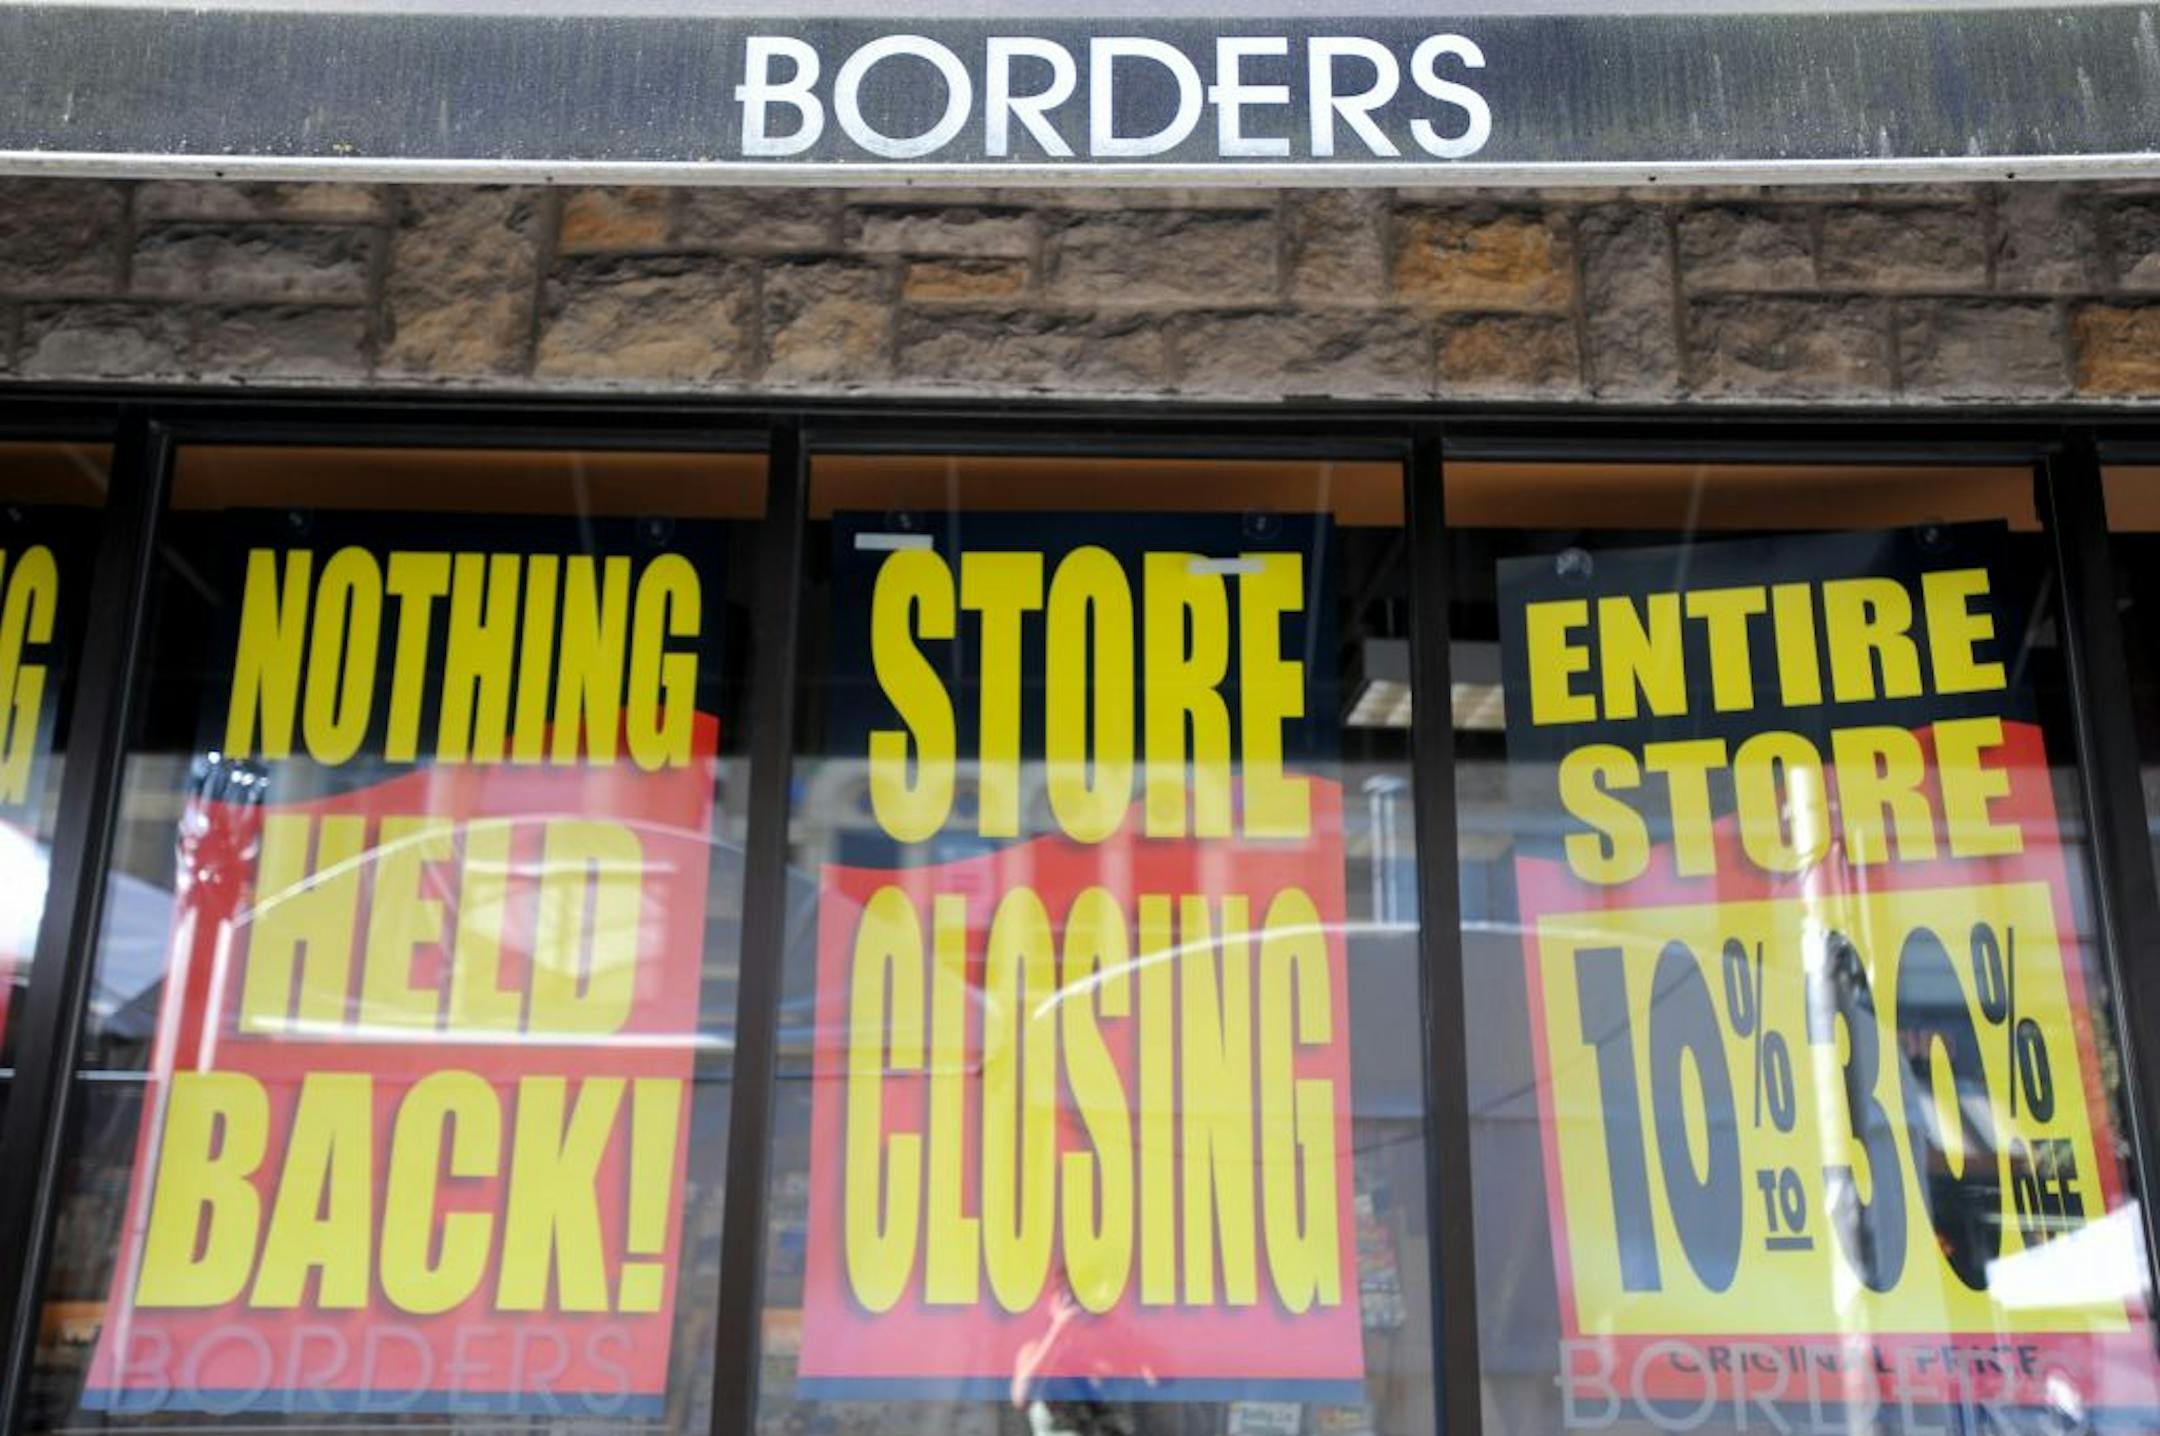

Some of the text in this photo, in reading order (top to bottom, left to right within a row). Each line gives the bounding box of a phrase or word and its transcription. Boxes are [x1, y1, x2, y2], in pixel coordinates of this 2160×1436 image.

[735, 34, 1492, 159] BORDERS
[225, 546, 702, 771] NOTHING
[868, 545, 1311, 843] STORE
[1525, 568, 2007, 725] ENTIRE
[1557, 717, 2024, 885] STORE
[238, 814, 644, 1036] HELD
[134, 1070, 682, 1315] BACK!
[845, 886, 1343, 1314] CLOSING
[1573, 937, 1796, 1293] 10%
[1757, 1167, 1806, 1234] TO
[1803, 922, 2054, 1293] 30%
[110, 1324, 637, 1414] BORDERS
[1668, 1345, 1894, 1375] ORIGINL
